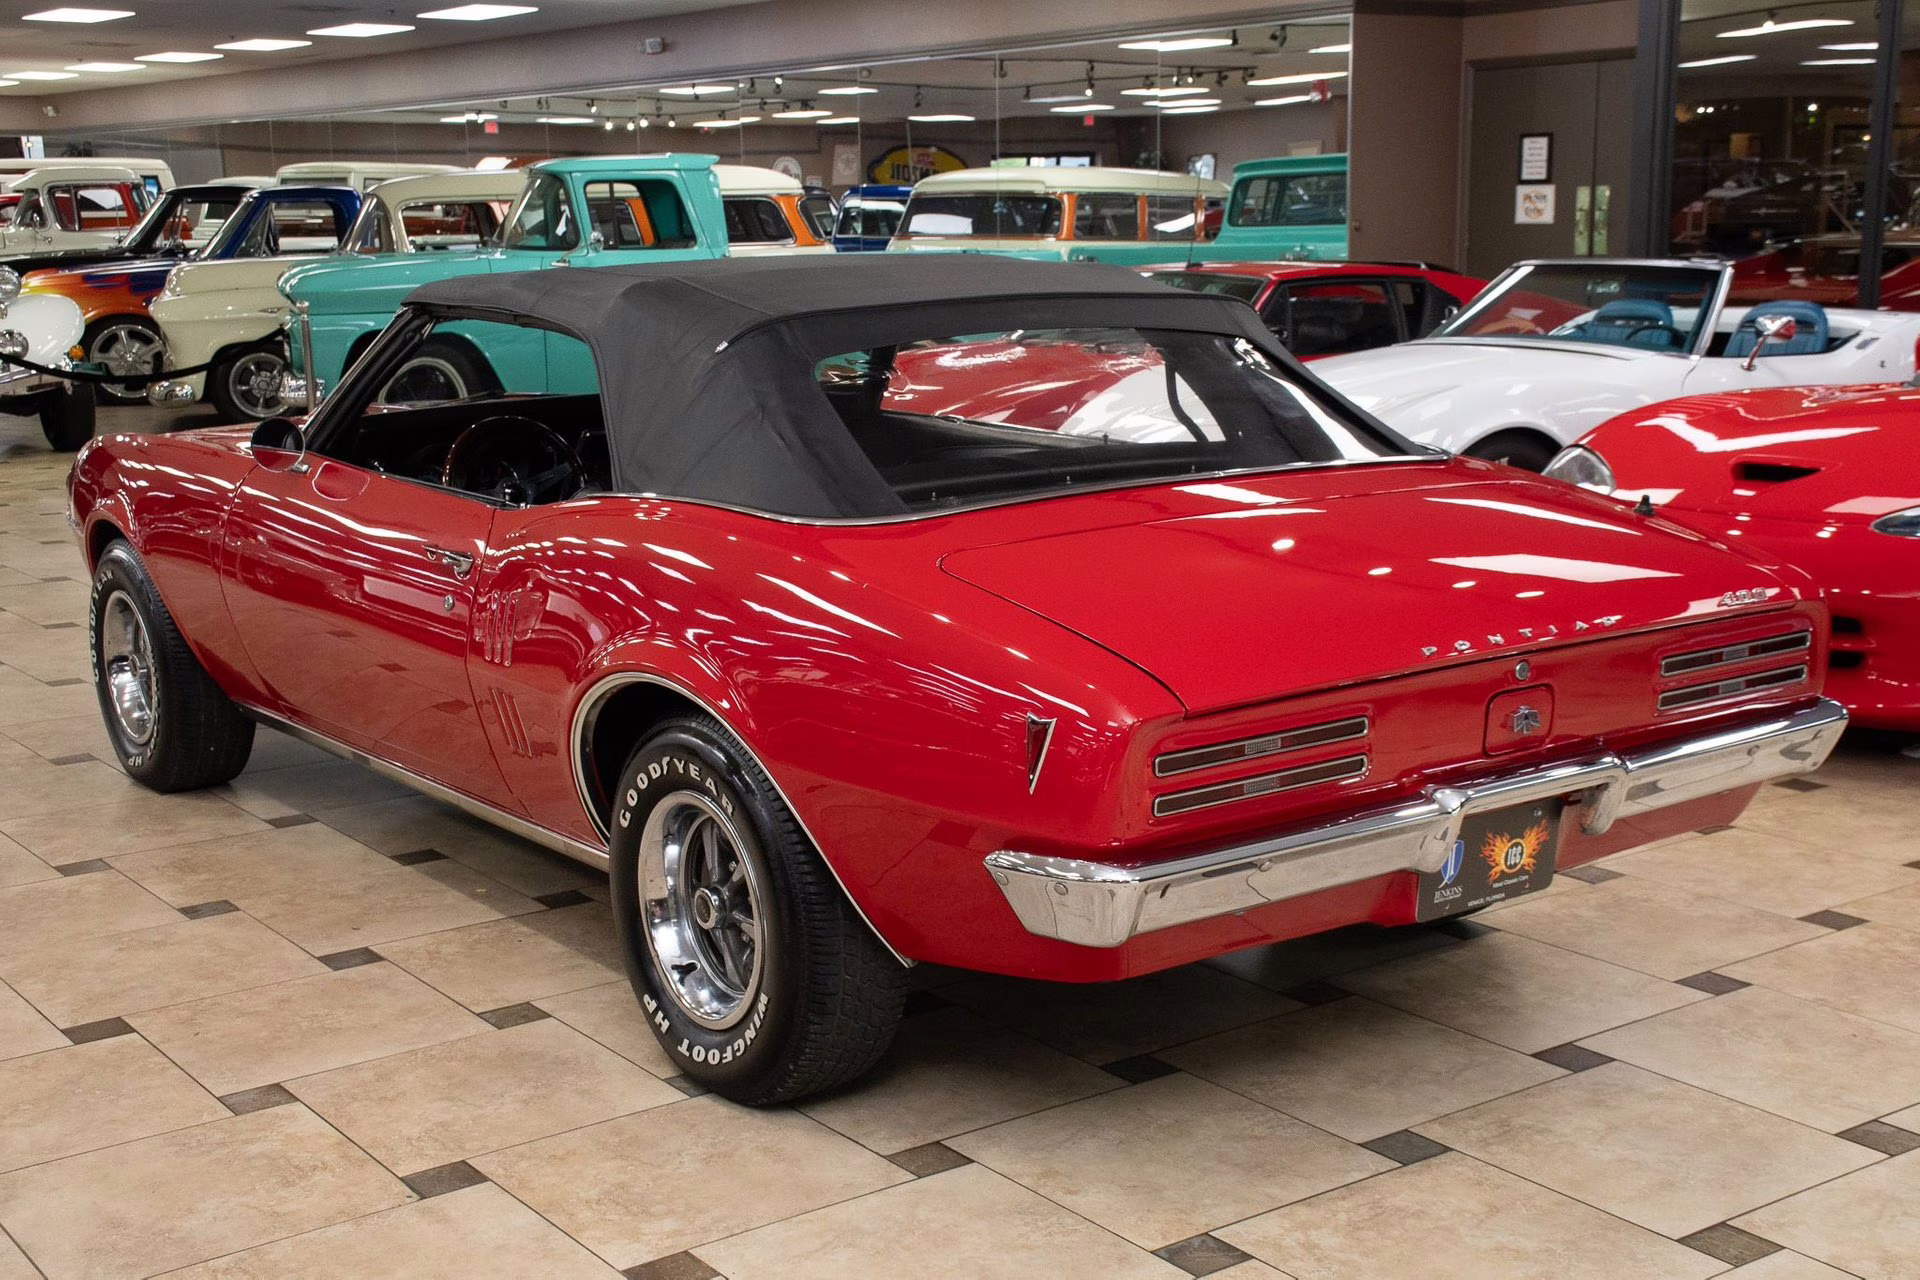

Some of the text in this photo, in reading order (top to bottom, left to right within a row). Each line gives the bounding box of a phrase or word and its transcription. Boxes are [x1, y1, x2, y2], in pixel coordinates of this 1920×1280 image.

[1719, 588, 1767, 606] 400
[1421, 615, 1618, 657] PONTIAC
[128, 755, 143, 767] HP
[619, 756, 736, 830] GOODYEAR
[642, 991, 770, 1065] WINGFOOT HP
